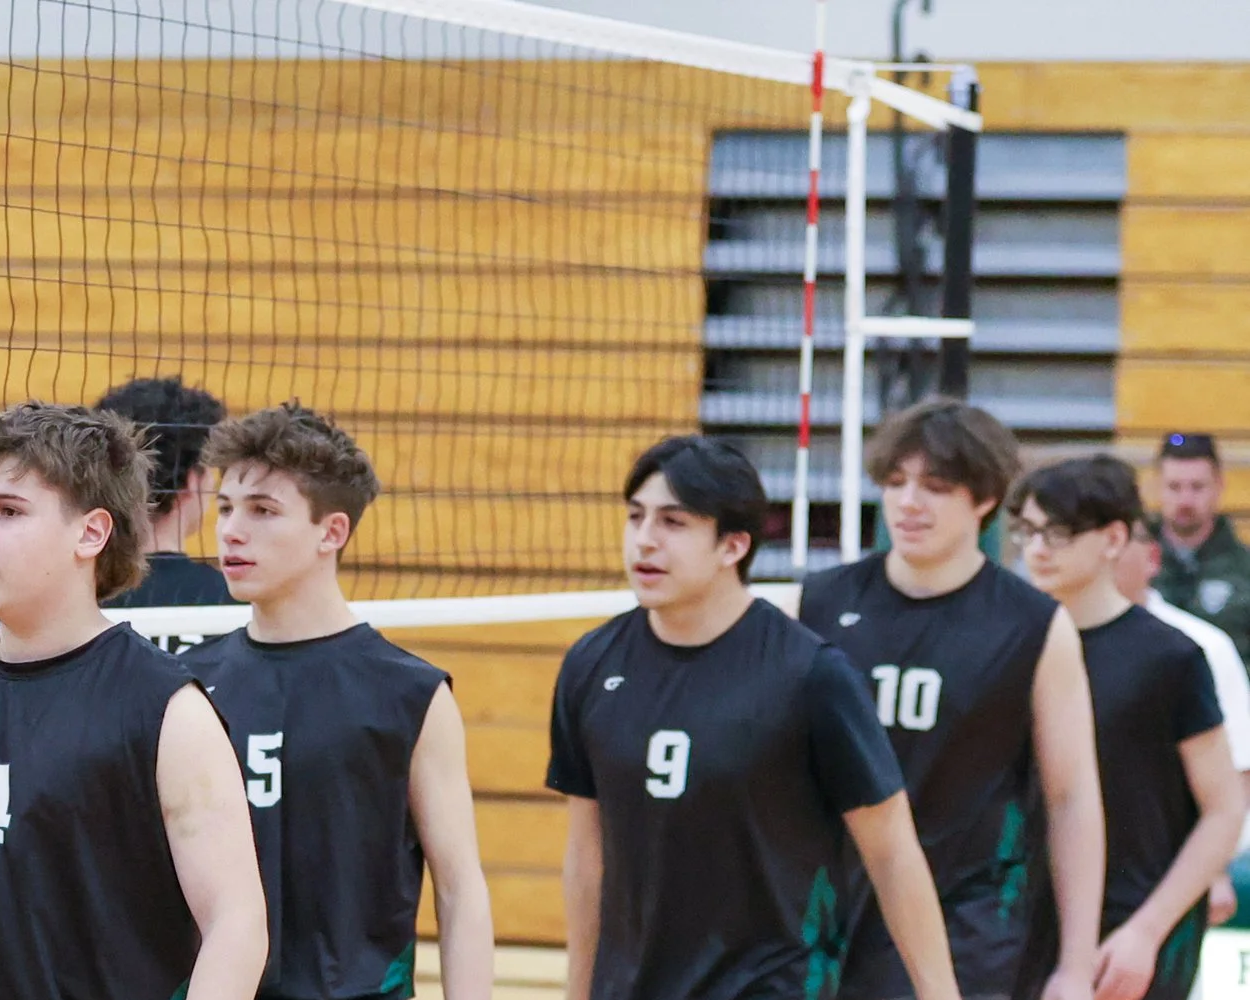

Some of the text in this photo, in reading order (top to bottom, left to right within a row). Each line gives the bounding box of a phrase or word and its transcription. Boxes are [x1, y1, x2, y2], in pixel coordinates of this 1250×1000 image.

[871, 664, 943, 732] 10
[247, 731, 284, 808] 5
[646, 729, 691, 799] 9
